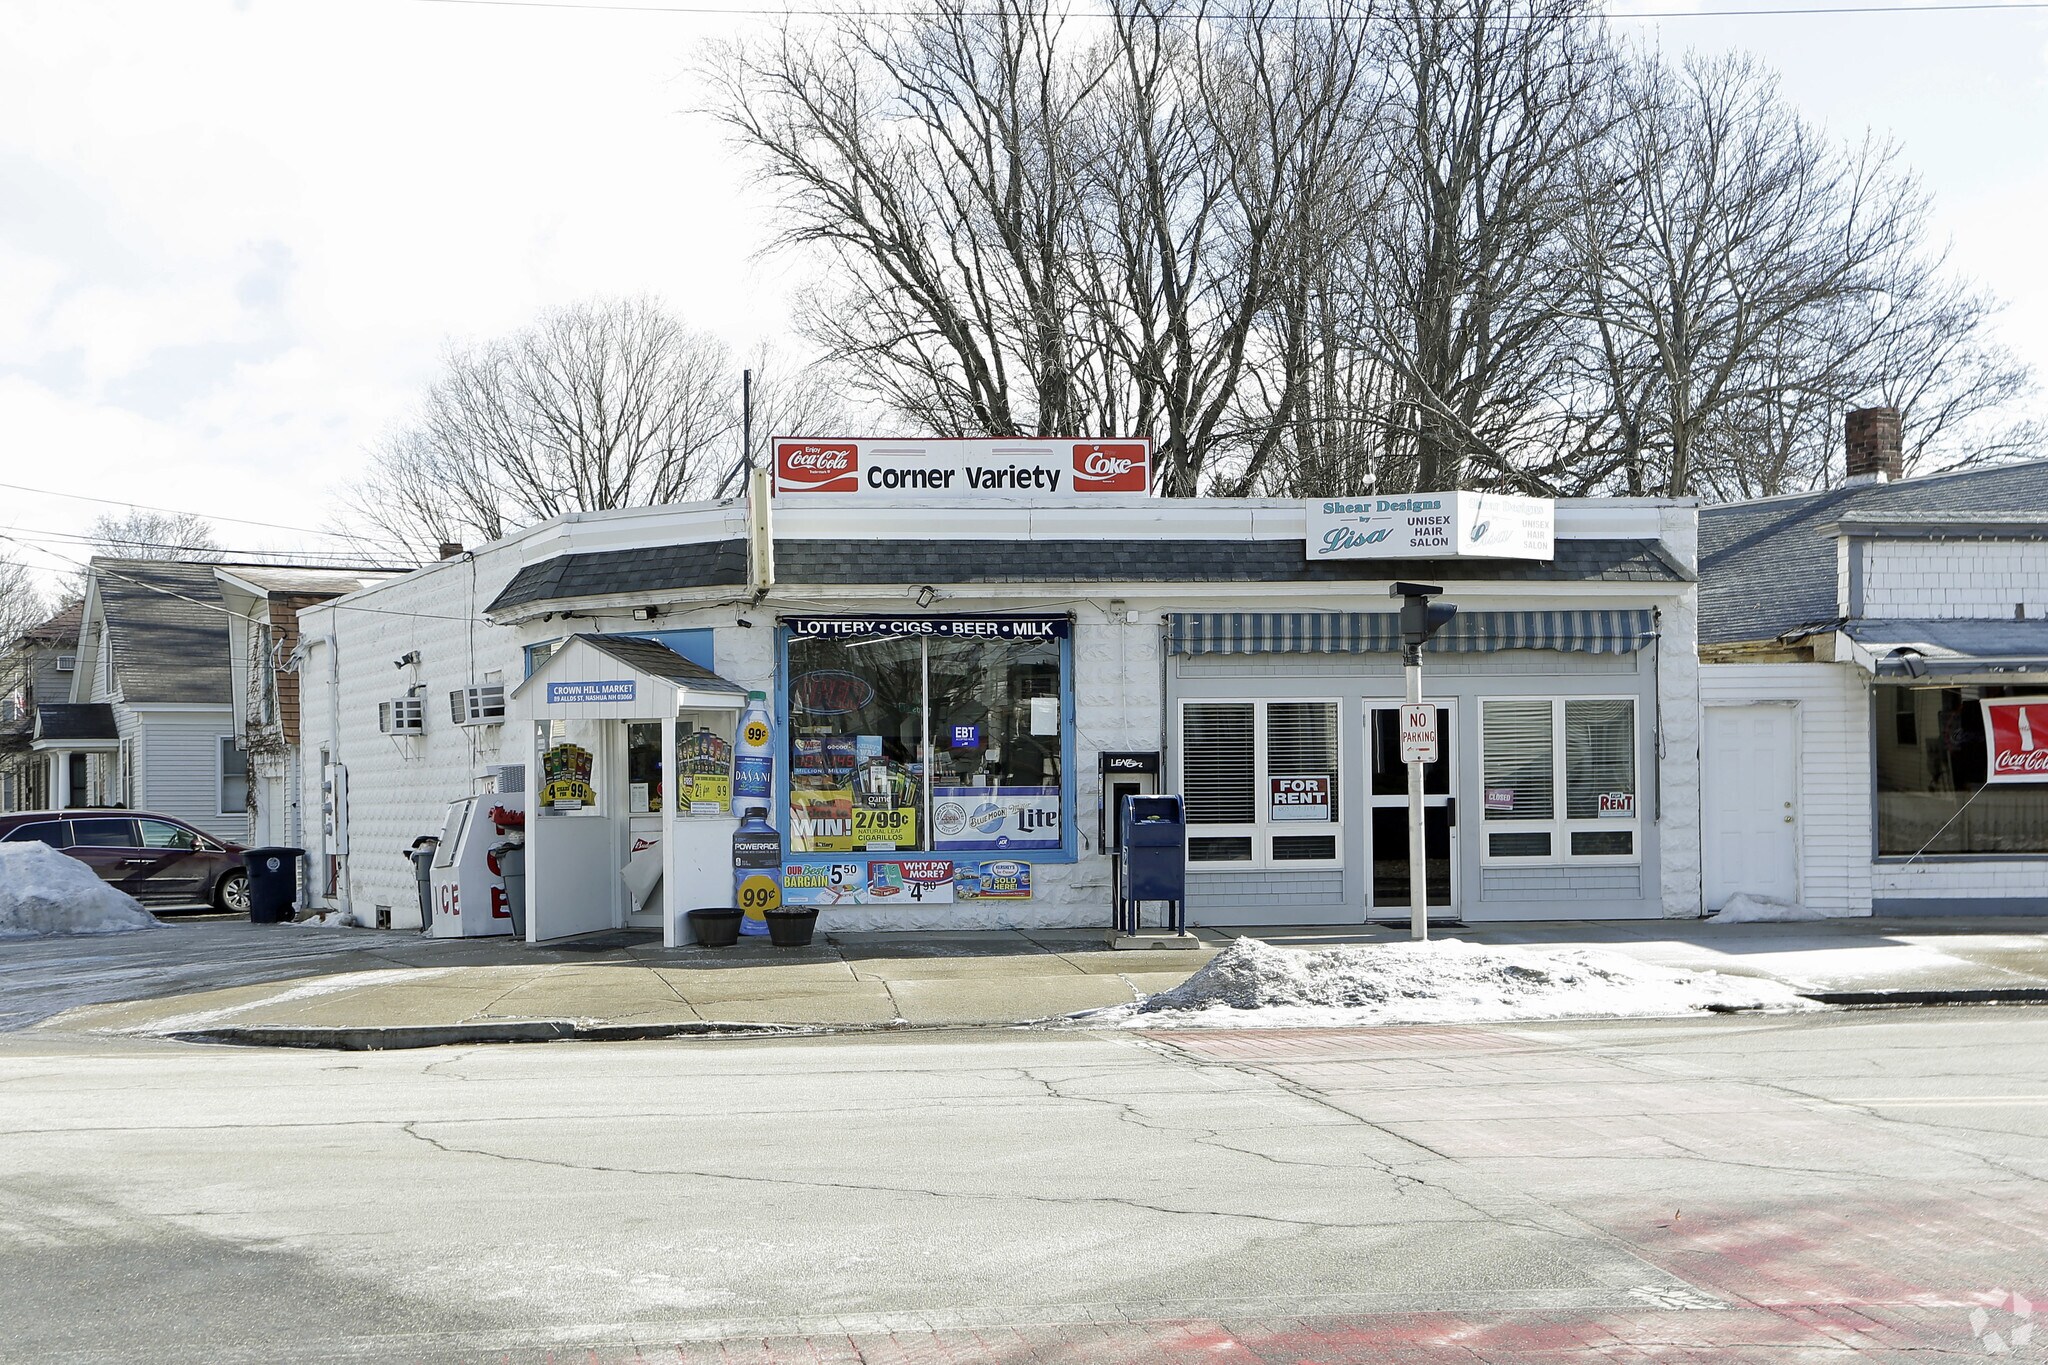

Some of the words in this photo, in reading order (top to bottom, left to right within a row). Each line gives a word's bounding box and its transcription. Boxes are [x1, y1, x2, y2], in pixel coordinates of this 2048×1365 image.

[787, 450, 850, 470] Coca-Cola
[1084, 451, 1132, 474] Coke
[867, 464, 956, 490] Corner
[965, 464, 1061, 492] Variety
[1323, 501, 1372, 514] Shear
[1376, 498, 1442, 512] Designs
[1359, 514, 1371, 523] by
[1407, 515, 1451, 526] UNISEX
[1522, 519, 1550, 529] UNISEX
[1414, 527, 1443, 537] HAIR
[1527, 530, 1545, 540] HAIR
[1318, 526, 1394, 554] Lisa
[1409, 537, 1449, 547] SALON
[1523, 541, 1548, 550] SALON
[797, 620, 876, 634] LOTTERY
[889, 621, 938, 634] CIGS.
[952, 621, 999, 635] BEER
[1013, 622, 1054, 636] MILK
[553, 686, 582, 695] CROWN
[583, 685, 600, 694] HILL
[602, 684, 633, 693] MARKET
[1409, 712, 1427, 728] NO
[748, 727, 767, 741] 99¢
[955, 726, 975, 738] EBT
[1403, 730, 1435, 743] PARKING
[1995, 749, 2048, 771] Coca-Col
[735, 768, 770, 783] DASANI
[548, 783, 556, 799] 4
[695, 783, 700, 798] 2
[1280, 779, 1319, 791] FOR
[1274, 792, 1326, 804] RENT
[1488, 793, 1511, 801] CLOSED
[1600, 795, 1633, 810] RENT
[855, 811, 909, 829] 2/99¢
[970, 815, 988, 828] BLUE
[988, 809, 1006, 821] MOON
[1017, 808, 1057, 833] Lite
[791, 818, 852, 837] WIN!
[735, 842, 780, 850] POWERADE
[787, 865, 803, 875] OUR
[803, 864, 826, 875] Best
[904, 862, 929, 870] WHY
[931, 862, 950, 870] PAY
[909, 870, 945, 878] MORE?
[784, 875, 829, 888] BARGAIN
[434, 883, 461, 916] ICE
[743, 888, 776, 907] 99¢
